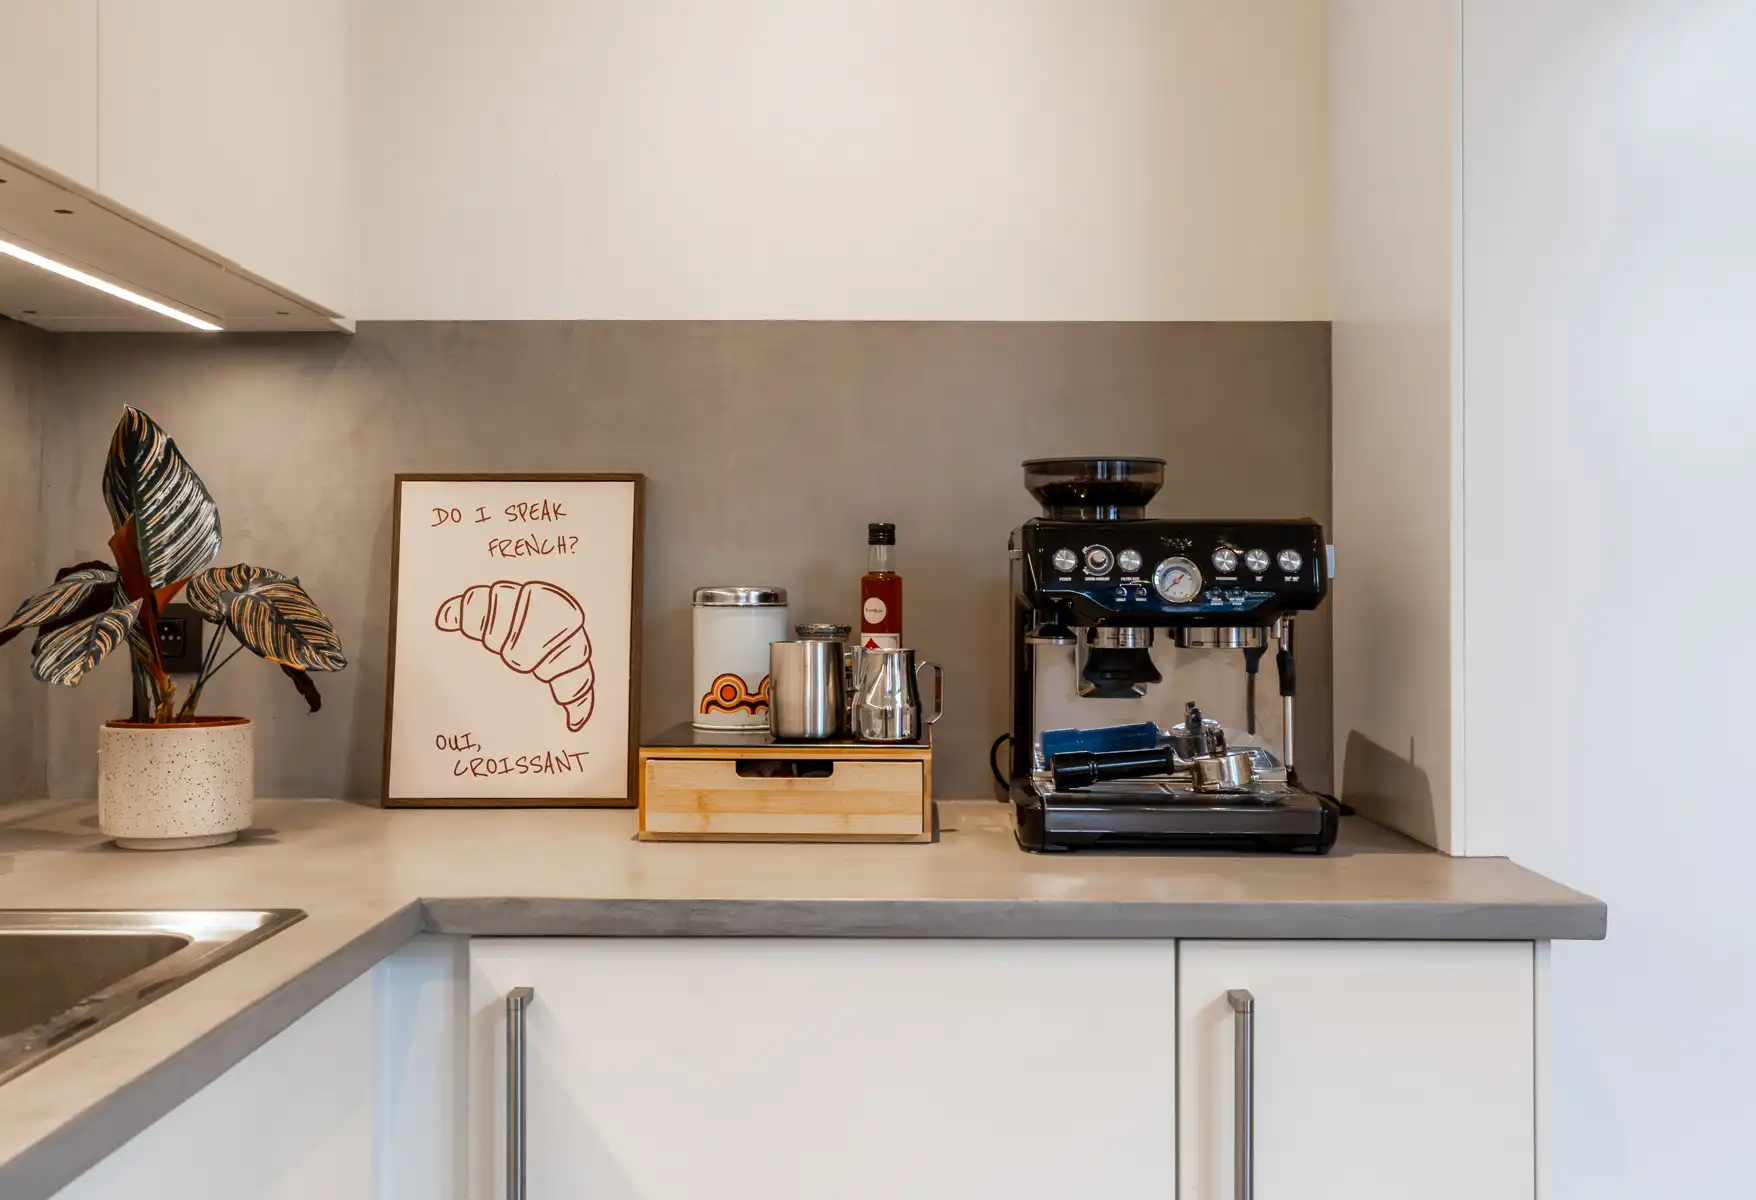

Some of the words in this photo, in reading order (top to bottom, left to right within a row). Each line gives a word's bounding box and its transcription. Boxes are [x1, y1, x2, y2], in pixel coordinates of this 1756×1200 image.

[431, 507, 462, 528] DO
[474, 506, 492, 524] I
[504, 498, 567, 523] SPEAK
[488, 533, 579, 559] FRENCH?
[435, 732, 482, 753] OUI,
[453, 750, 590, 778] CROISSANT
